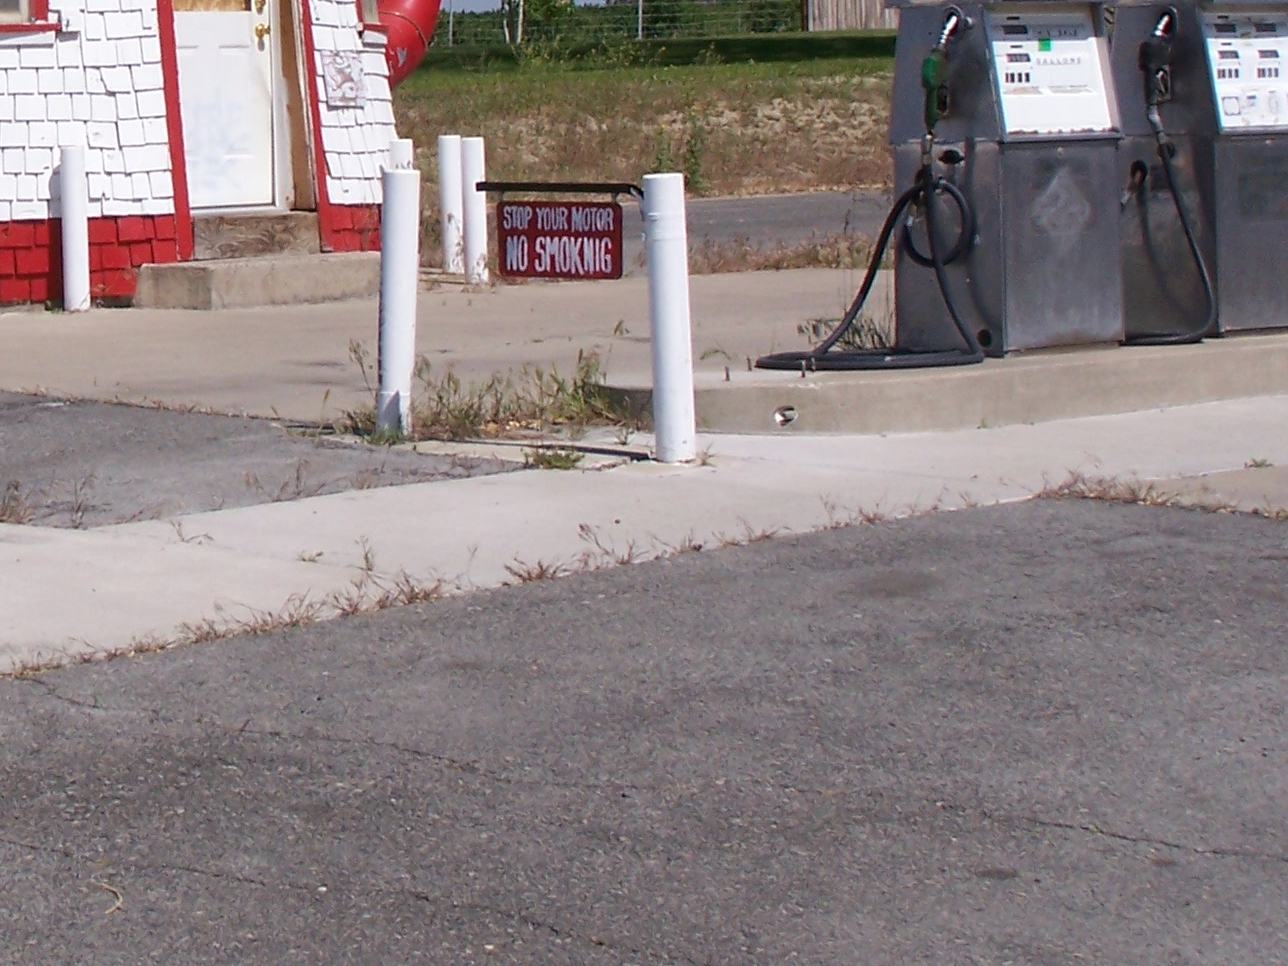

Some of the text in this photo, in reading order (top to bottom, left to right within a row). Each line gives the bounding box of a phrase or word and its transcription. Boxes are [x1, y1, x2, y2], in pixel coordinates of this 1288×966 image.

[502, 205, 614, 232] STOP YOUR MOTOR
[506, 235, 528, 272] NO
